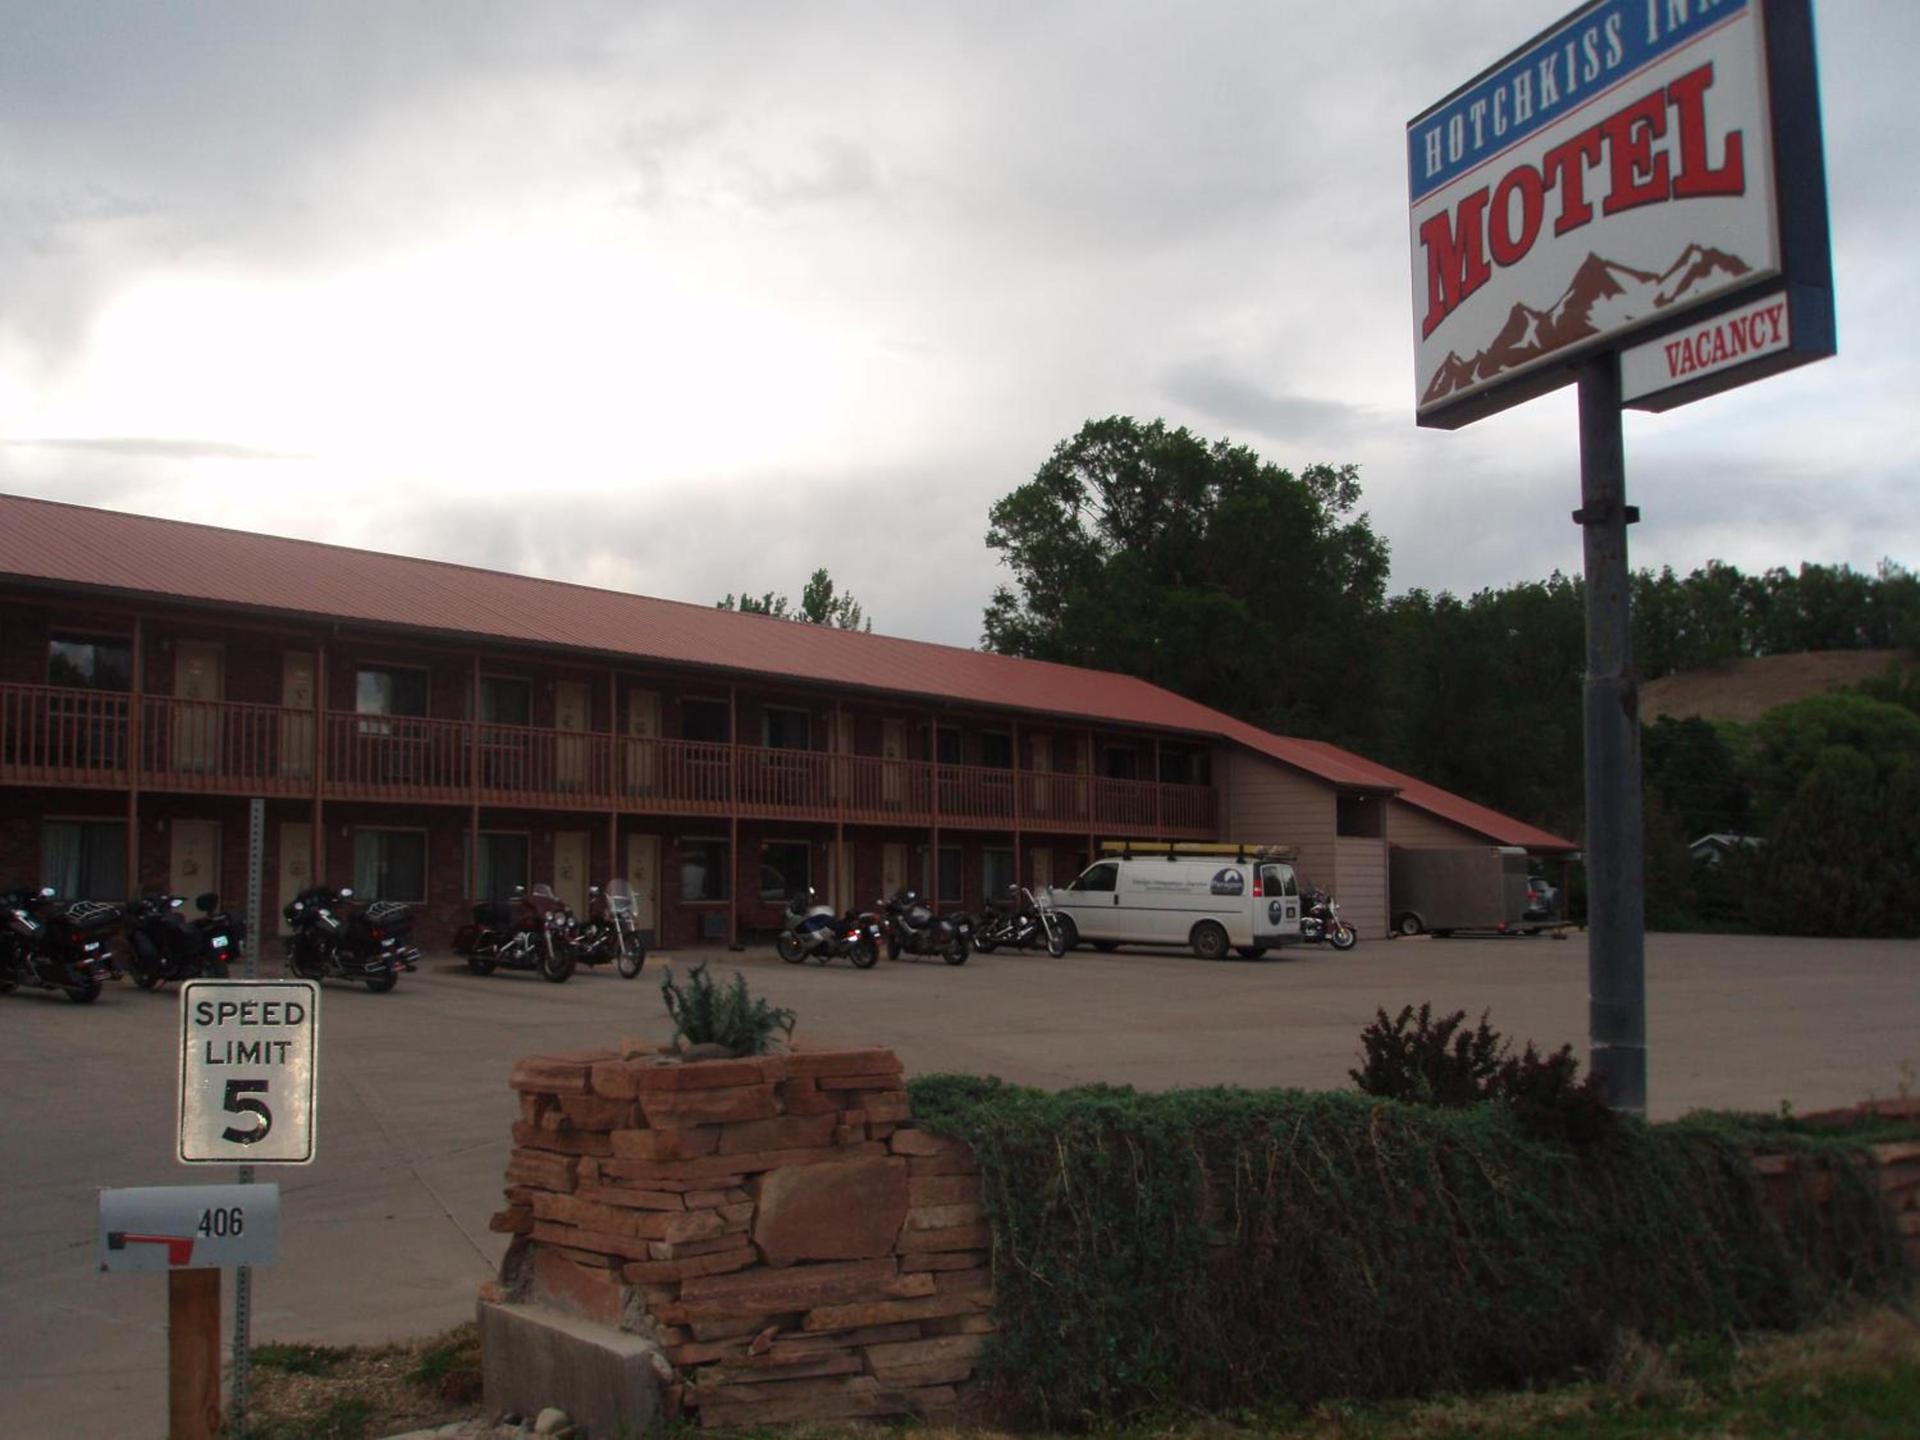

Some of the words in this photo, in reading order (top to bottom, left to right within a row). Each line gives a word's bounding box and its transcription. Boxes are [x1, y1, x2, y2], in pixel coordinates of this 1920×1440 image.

[1425, 12, 1623, 178] HOTCHKISS
[1647, 0, 1720, 44] IN
[1419, 62, 1745, 342] MOTEL
[1665, 303, 1785, 378] VACANCY
[195, 1001, 306, 1026] SPEED
[205, 1041, 292, 1065] LIMIT
[222, 1079, 272, 1144] 5
[198, 1207, 244, 1237] 406
